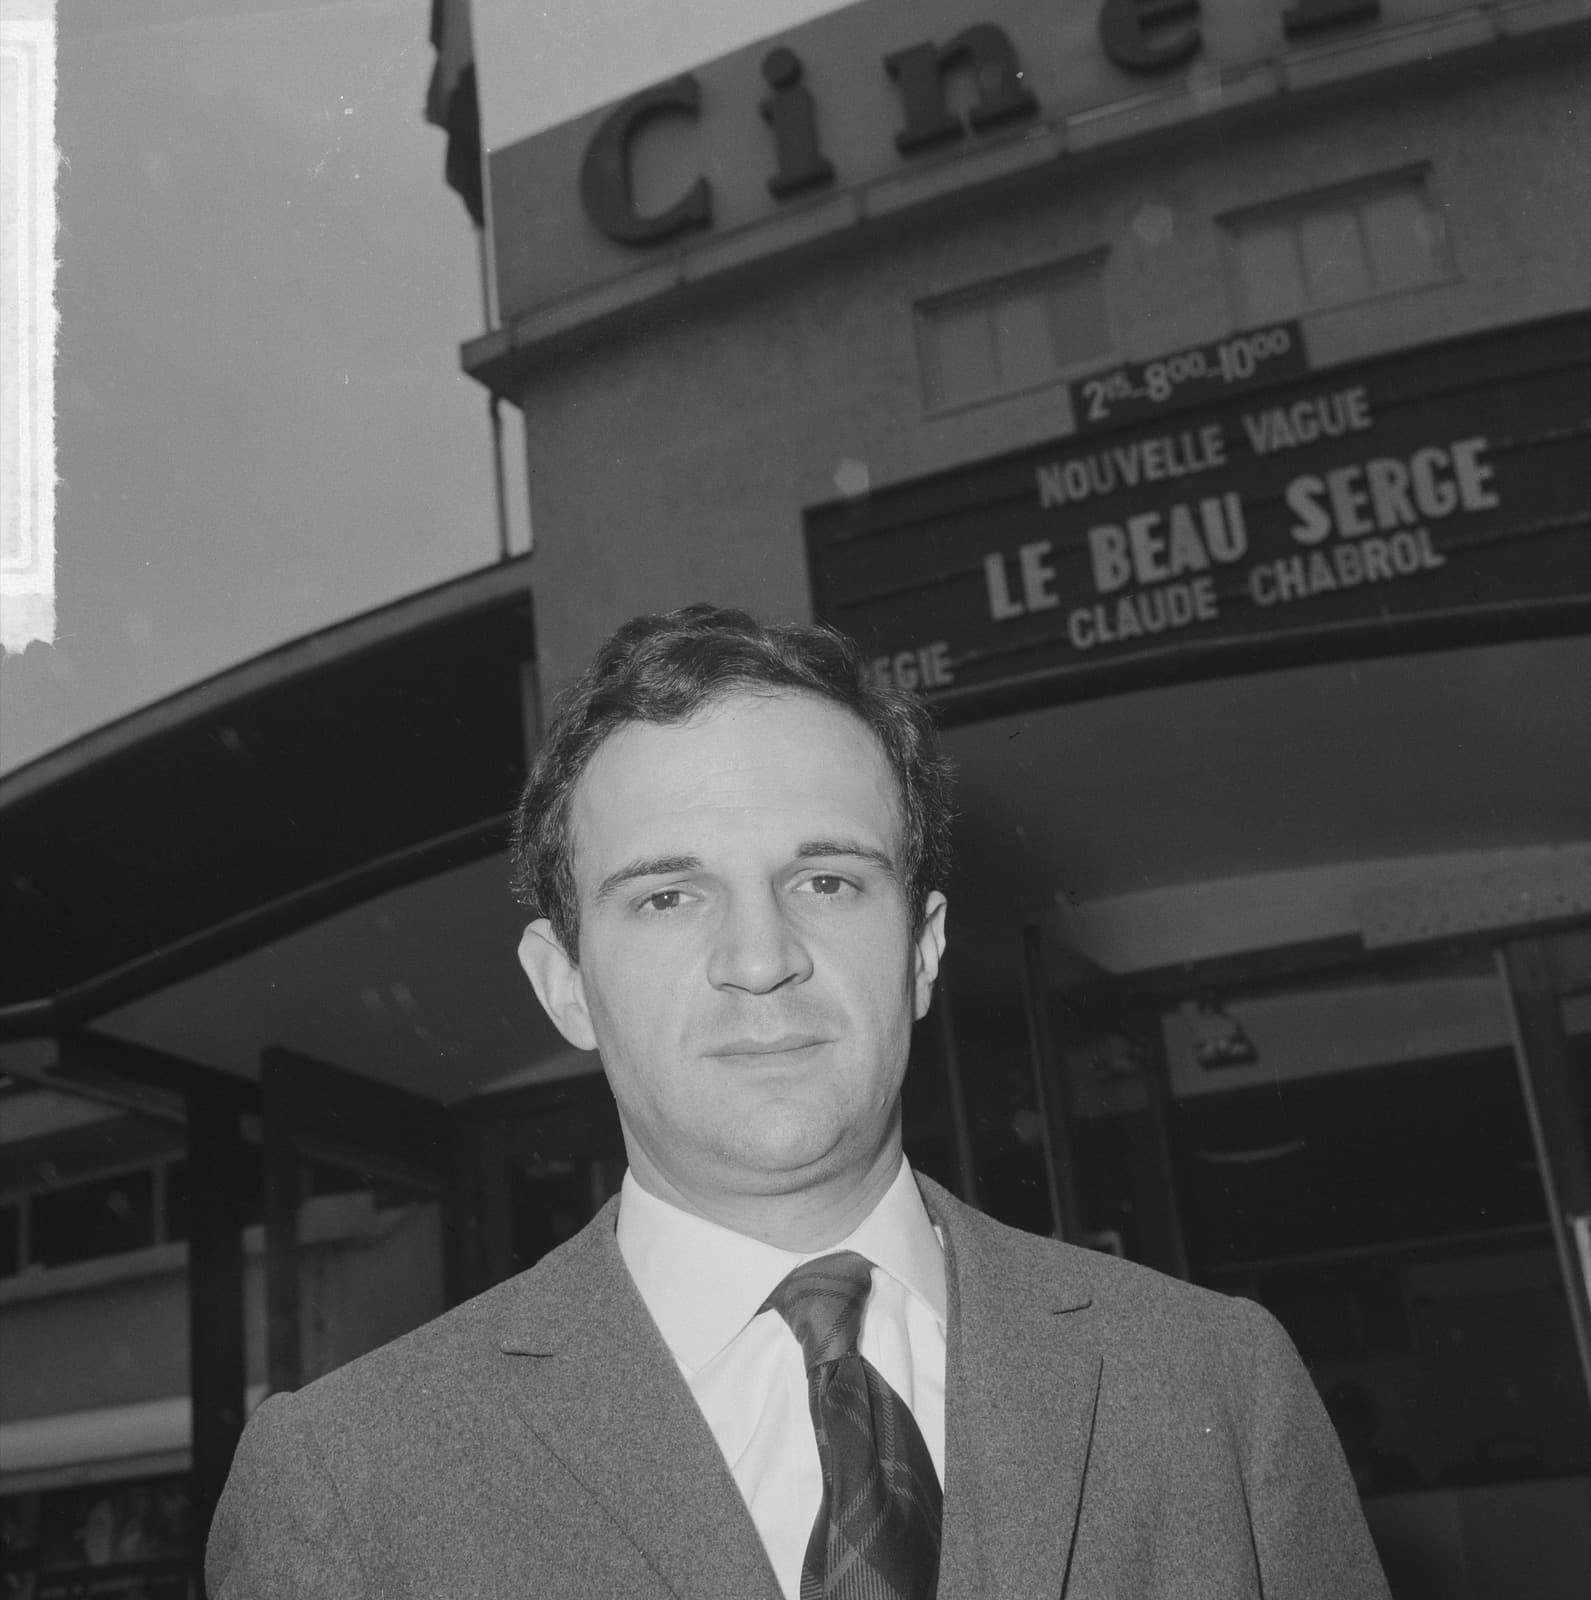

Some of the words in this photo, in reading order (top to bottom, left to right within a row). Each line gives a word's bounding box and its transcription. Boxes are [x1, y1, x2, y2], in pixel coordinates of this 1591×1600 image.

[577, 0, 1381, 247] Cine
[1035, 423, 1228, 509] NOUVELLE
[1242, 386, 1374, 456] VAGUE
[984, 539, 1061, 623] LE
[1088, 491, 1249, 595] BEAU
[1285, 436, 1500, 546] SERGE
[1066, 576, 1220, 651] CLAUDE
[1248, 525, 1446, 607] CHABROL
